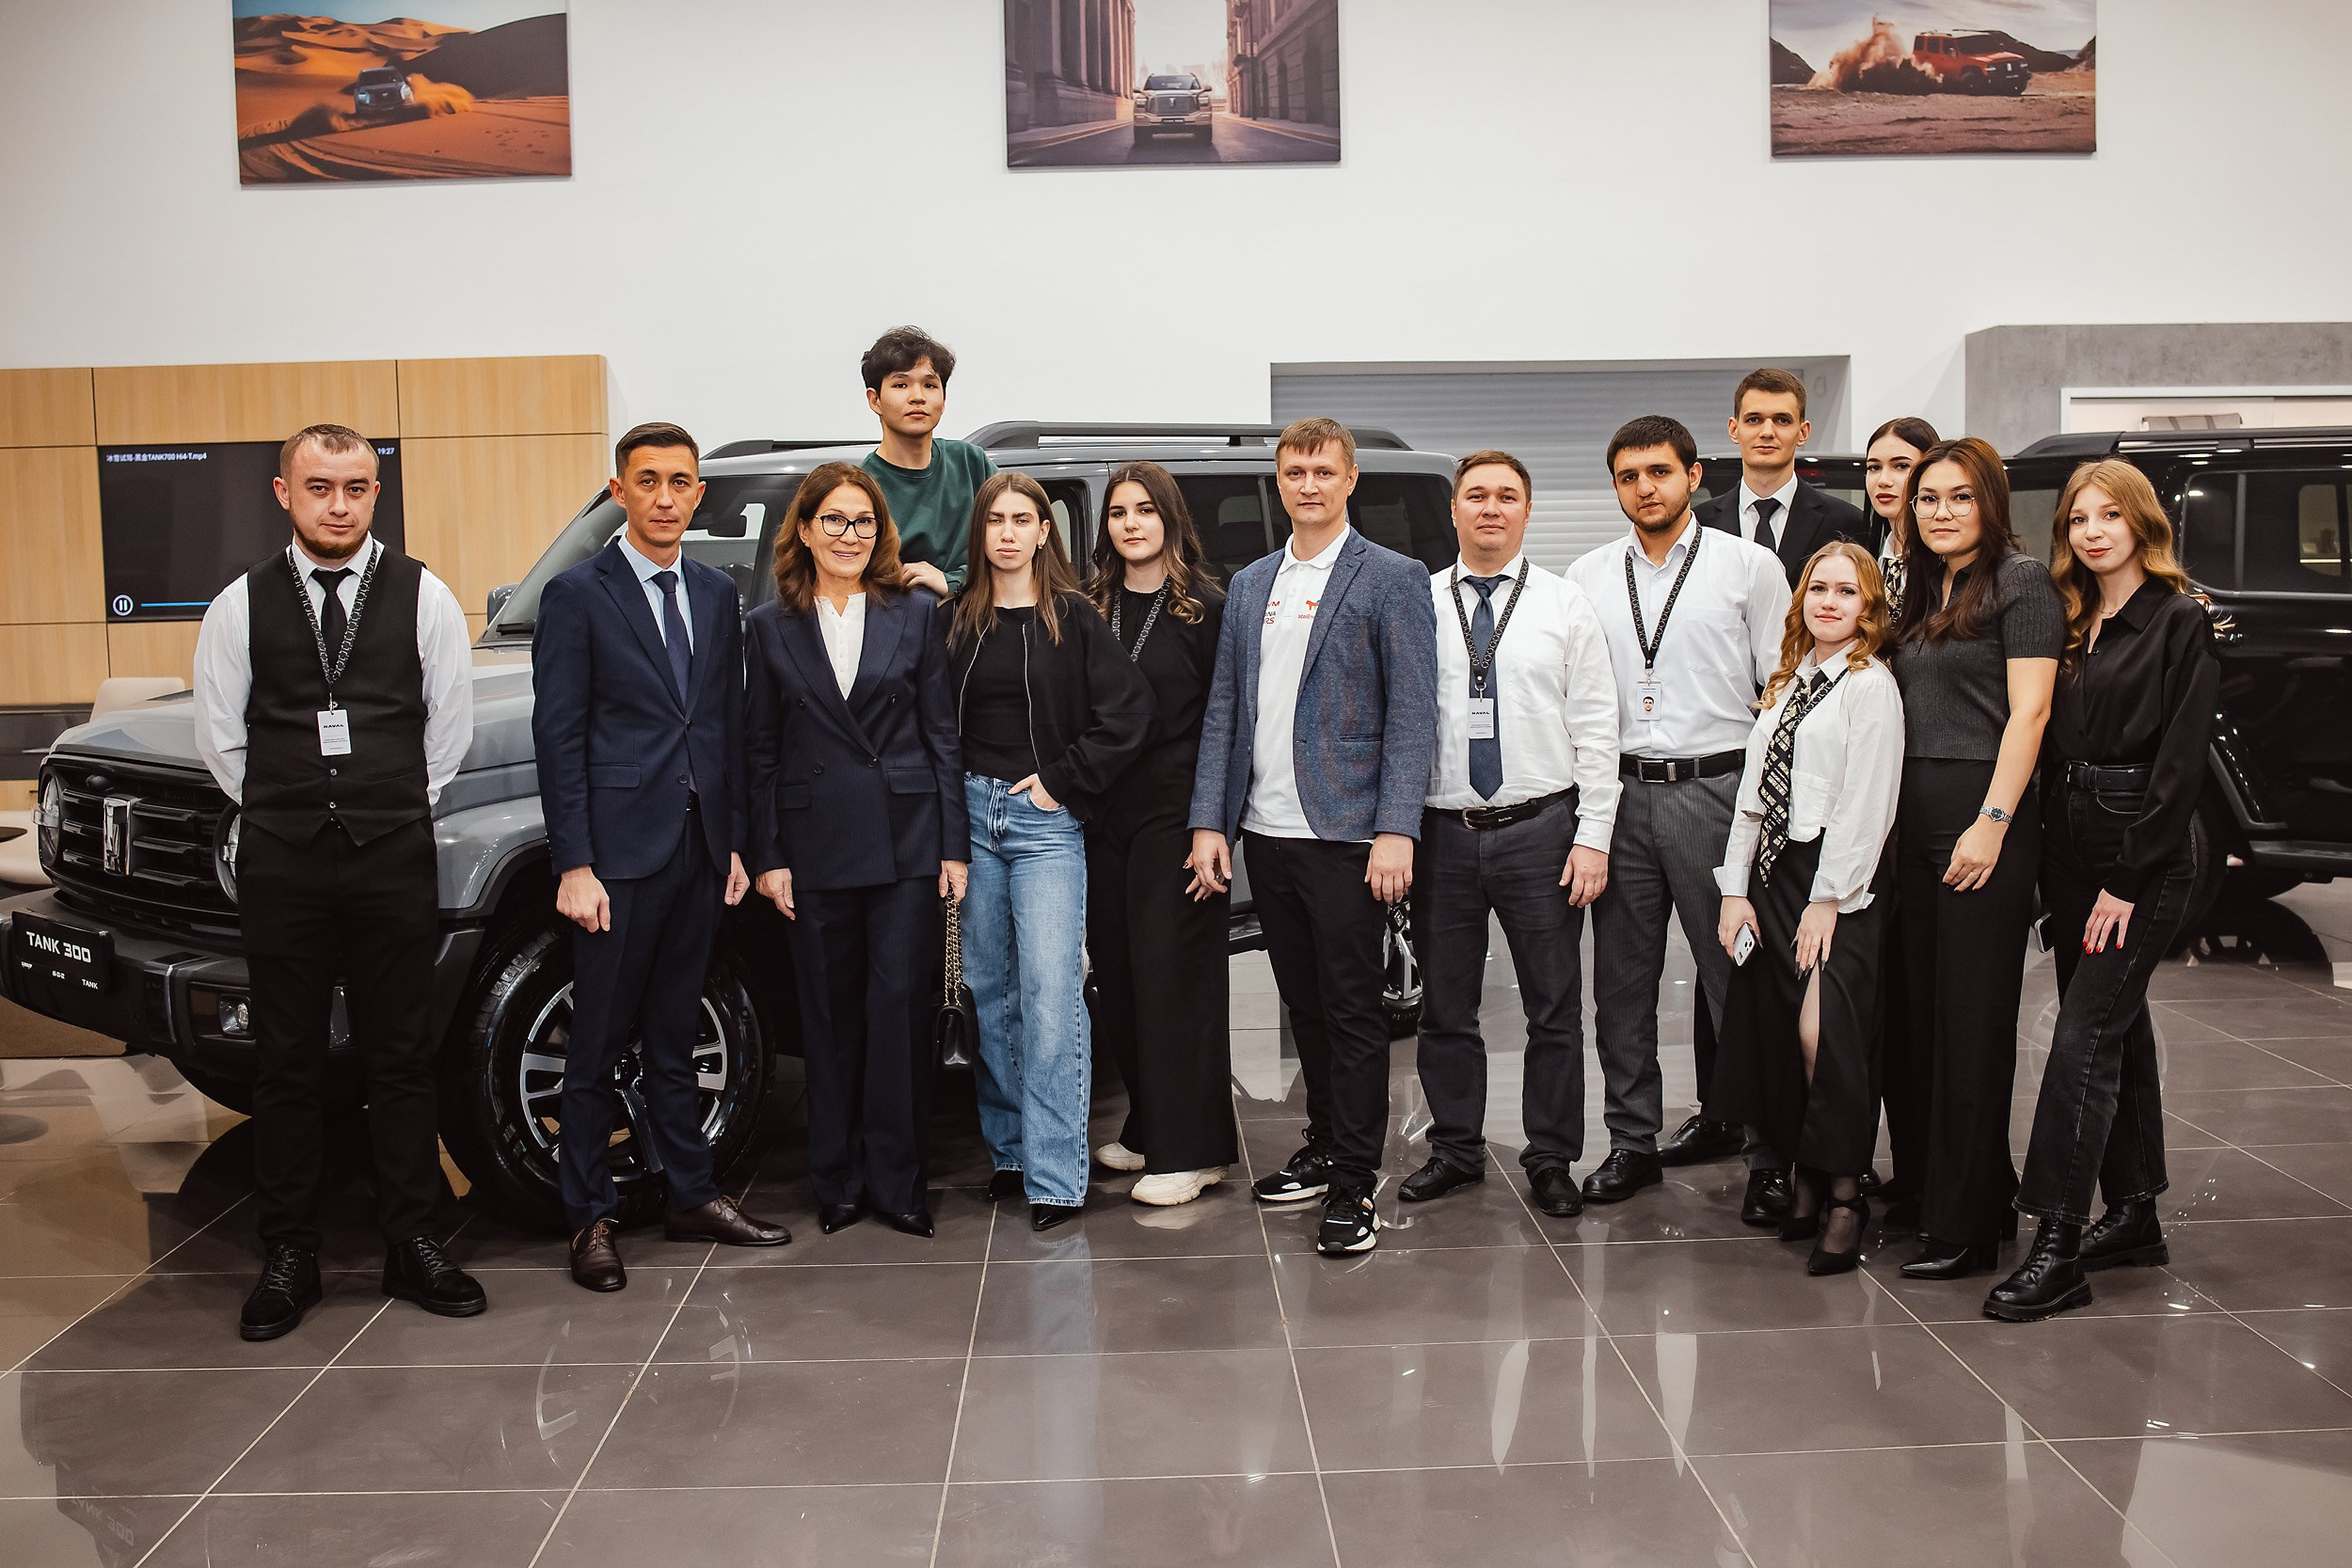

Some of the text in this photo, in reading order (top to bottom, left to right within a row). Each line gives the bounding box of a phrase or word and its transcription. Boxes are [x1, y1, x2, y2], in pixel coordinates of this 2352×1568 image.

[377, 447, 395, 455] 19:27
[25, 930, 91, 963] TANK 300
[81, 978, 99, 990] TANK
